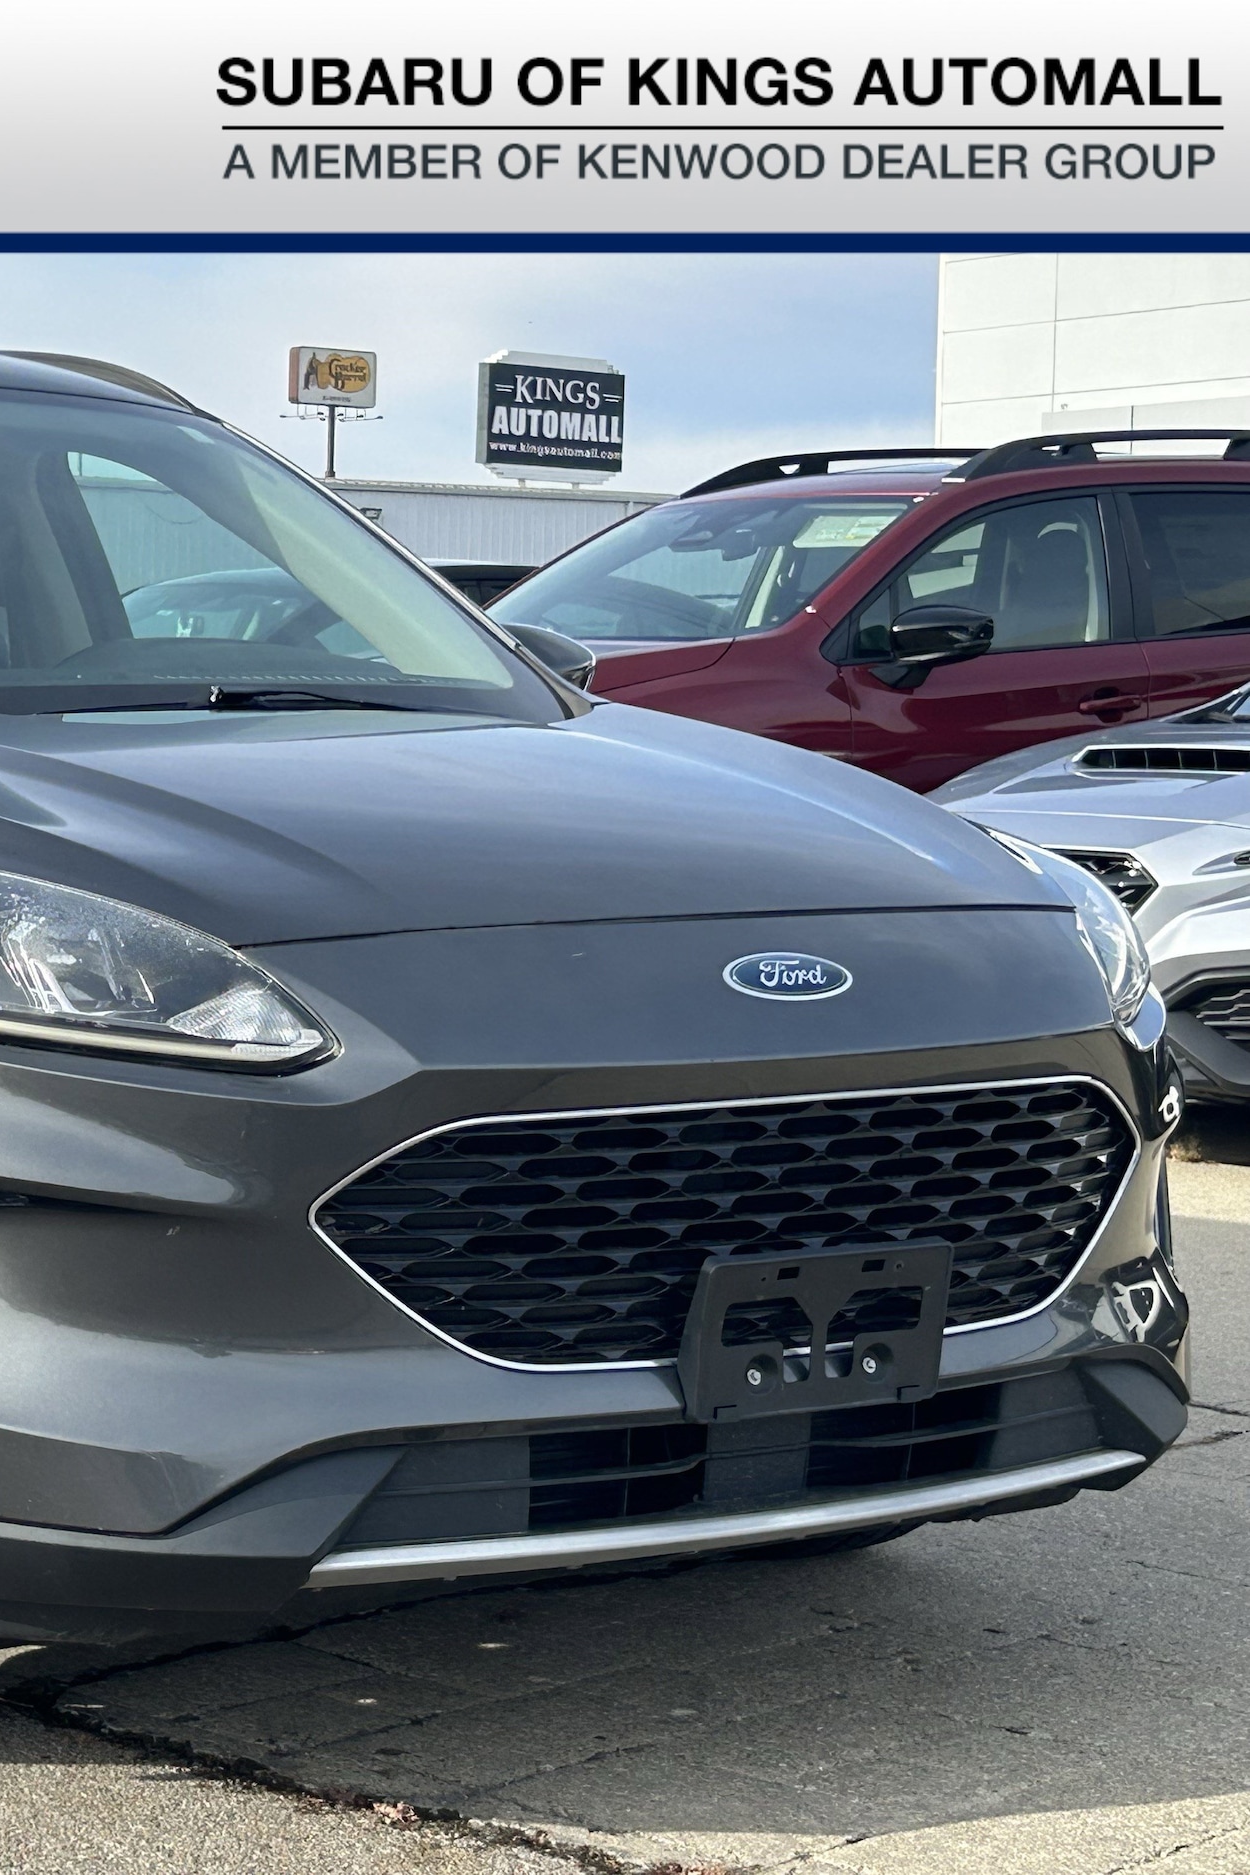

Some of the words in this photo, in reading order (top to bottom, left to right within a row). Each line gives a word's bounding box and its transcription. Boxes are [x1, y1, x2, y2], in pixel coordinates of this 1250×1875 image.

[514, 374, 600, 410] KINGS
[491, 405, 622, 444] AUTOMALL
[758, 960, 827, 987] Ford
